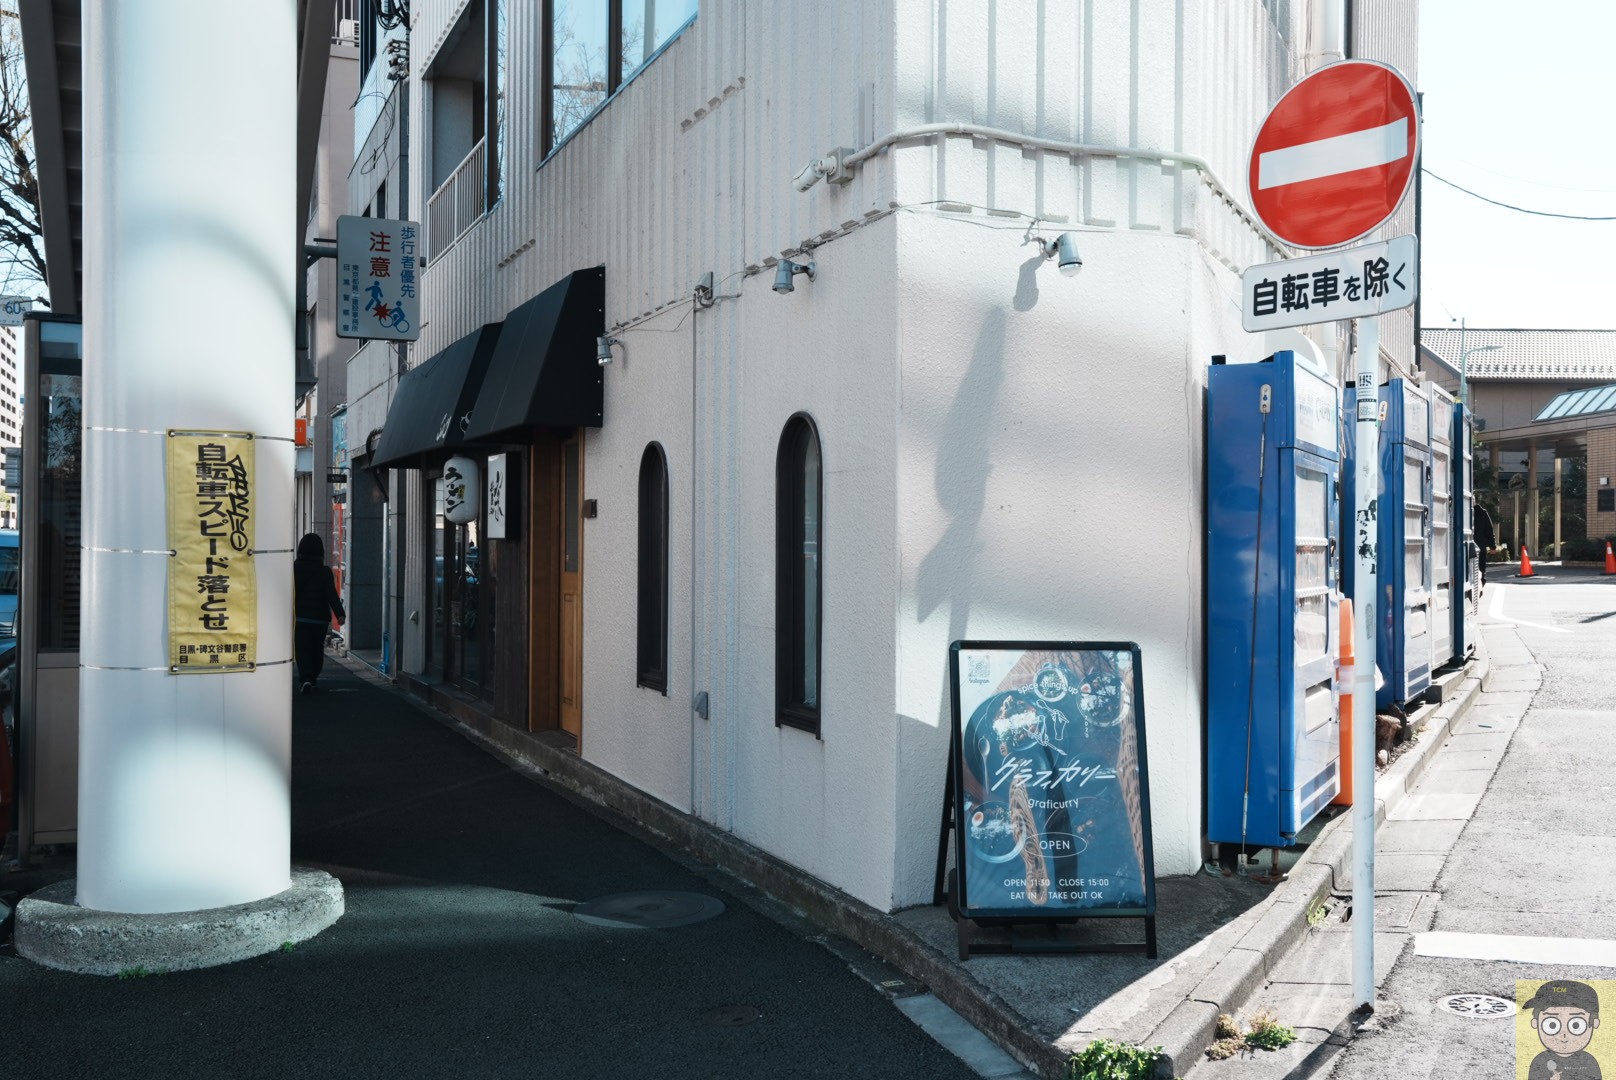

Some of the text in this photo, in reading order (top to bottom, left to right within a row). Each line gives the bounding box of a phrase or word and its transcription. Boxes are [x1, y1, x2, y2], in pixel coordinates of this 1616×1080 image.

[369, 231, 391, 278] 注意
[401, 226, 415, 298] 歩行者優先
[1253, 256, 1406, 316] 自転車を除く
[196, 443, 230, 631] 自転車スピード落とせ
[1017, 682, 1039, 695] spice
[1068, 685, 1079, 695] up
[1027, 797, 1080, 810] graficurry
[1039, 840, 1070, 850] OPEN
[1003, 878, 1026, 887] OPEN
[1058, 878, 1085, 886] CLOSE
[1088, 878, 1109, 886] 15:00
[1010, 891, 1025, 900] EAT
[1027, 891, 1037, 900] IN
[1048, 891, 1068, 900] TAKE
[1070, 891, 1088, 900] OUT
[1090, 891, 1103, 900] OK
